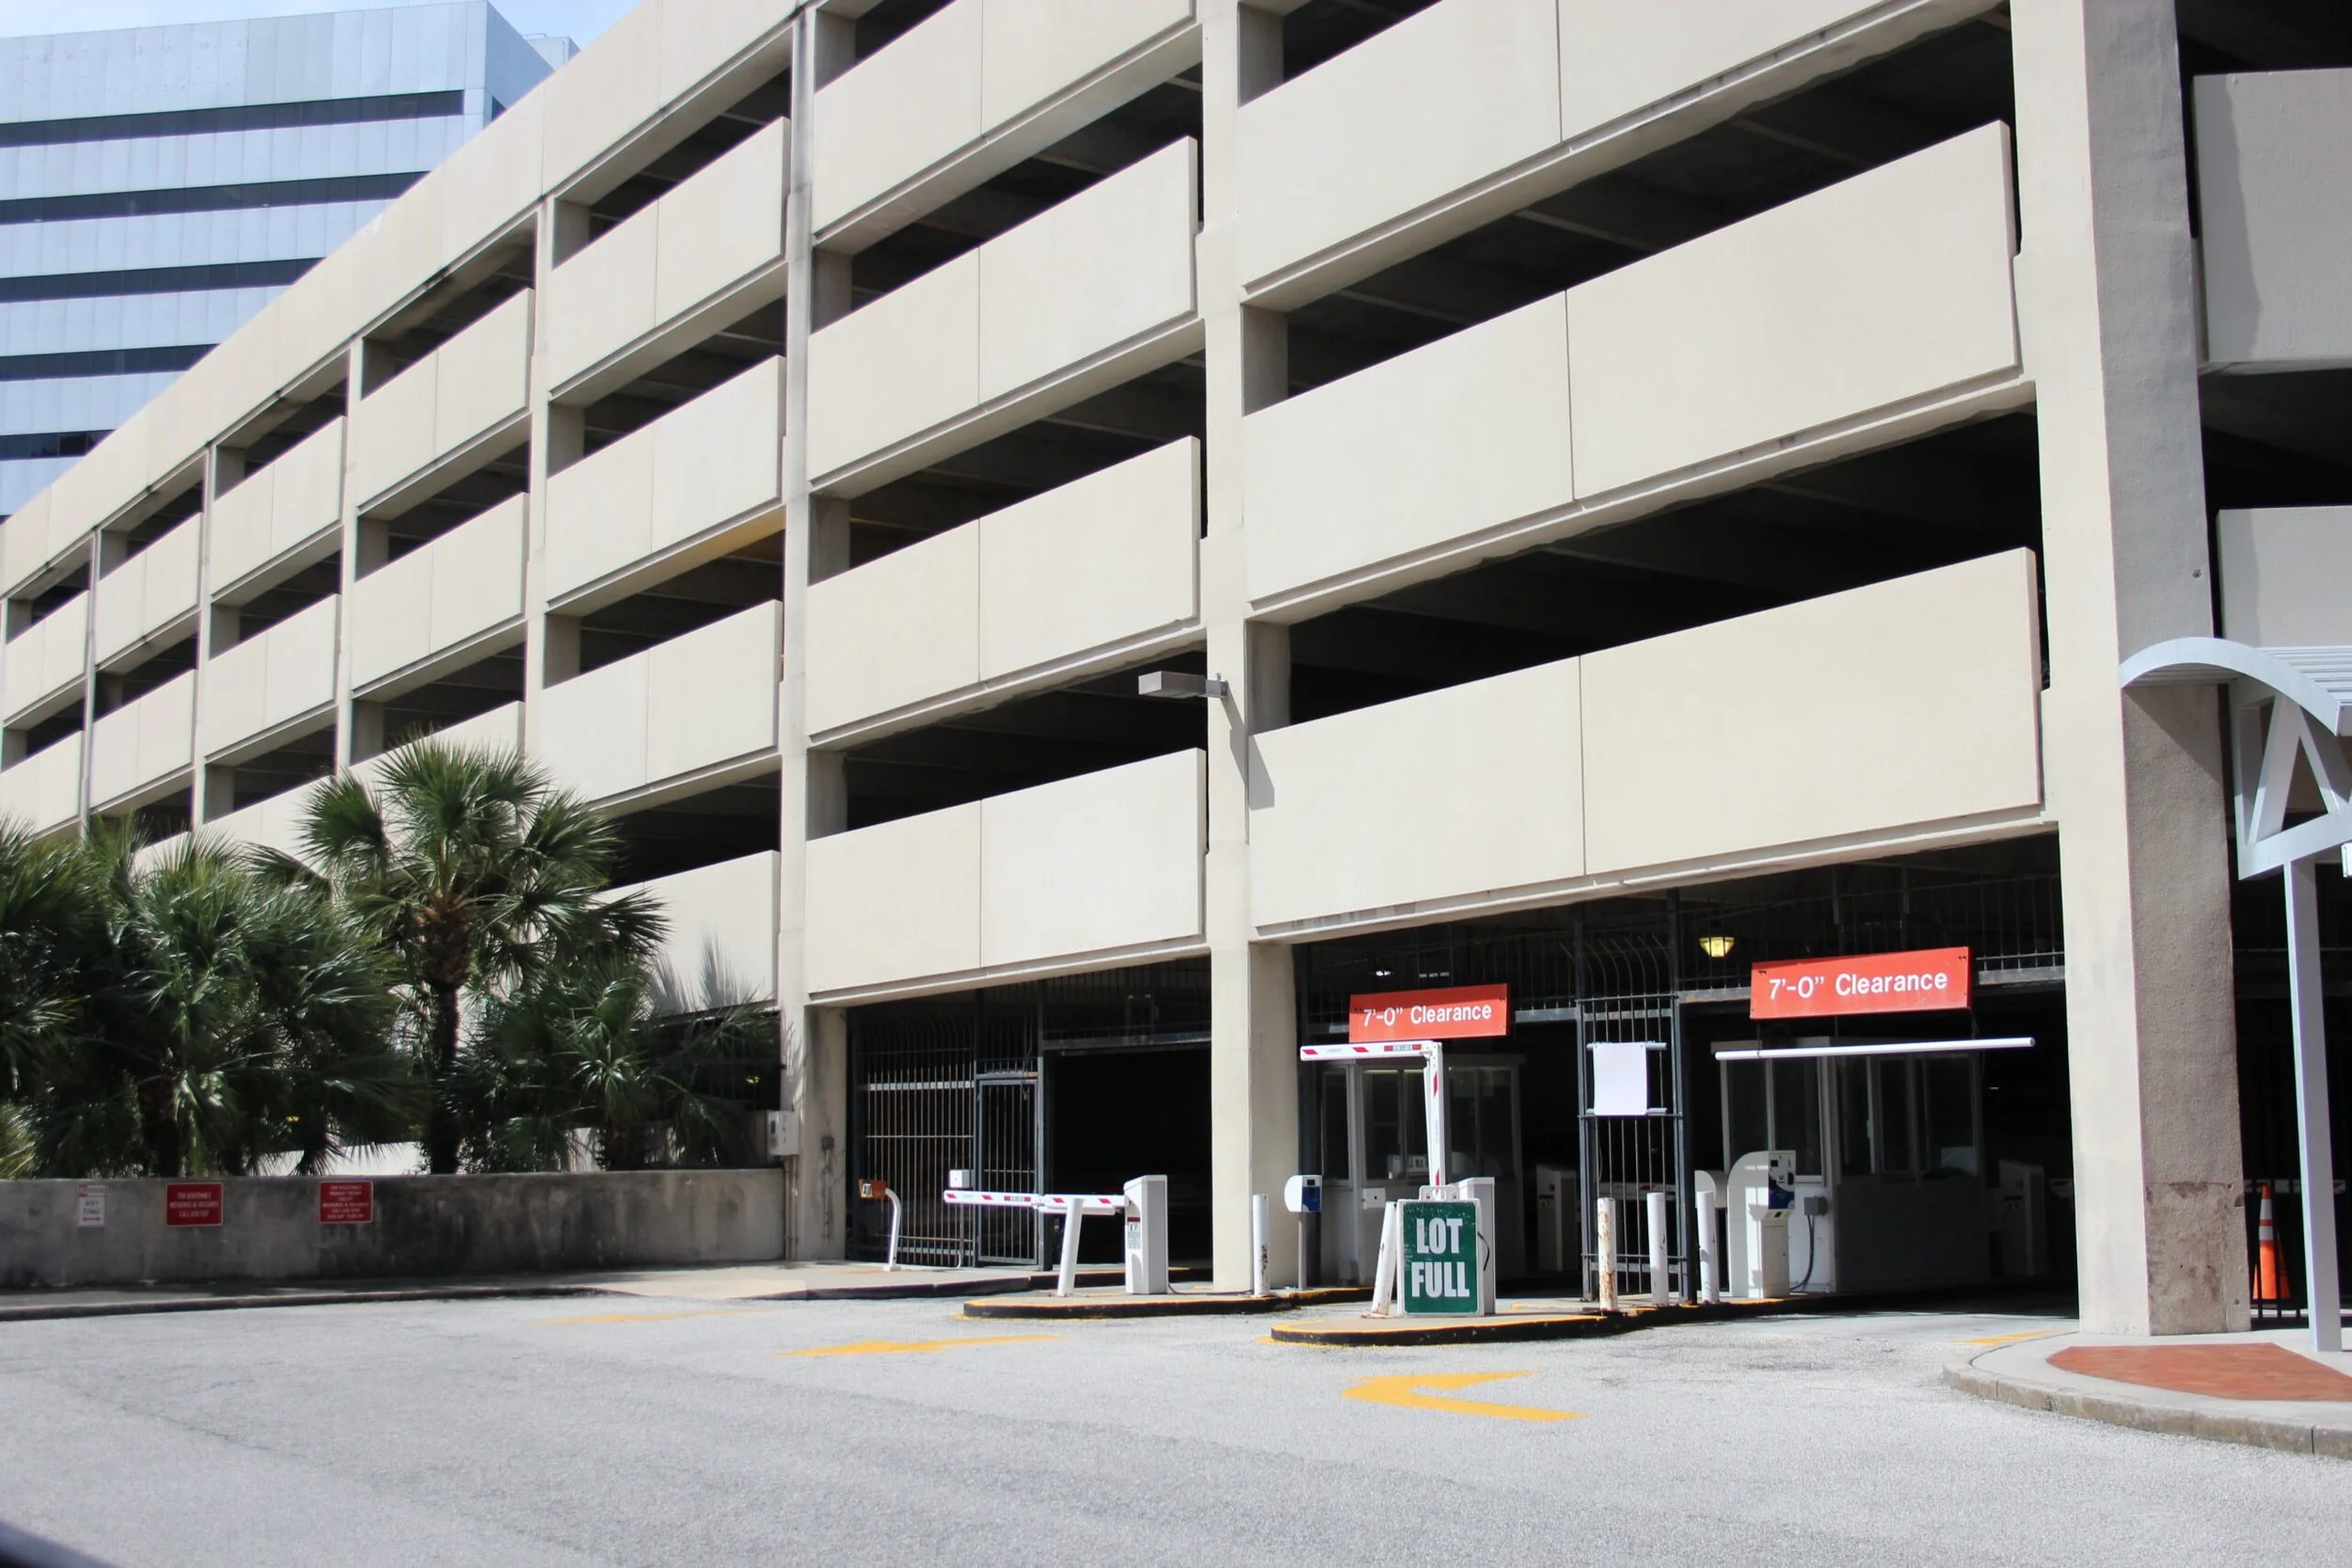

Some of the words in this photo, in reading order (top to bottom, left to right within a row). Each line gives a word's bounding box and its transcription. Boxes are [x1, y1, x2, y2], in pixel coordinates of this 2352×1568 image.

[1835, 972, 1948, 997] Clearance
[1410, 1005, 1493, 1024] Clearance
[1416, 1217, 1464, 1254] LOT
[1411, 1261, 1470, 1298] FULL
